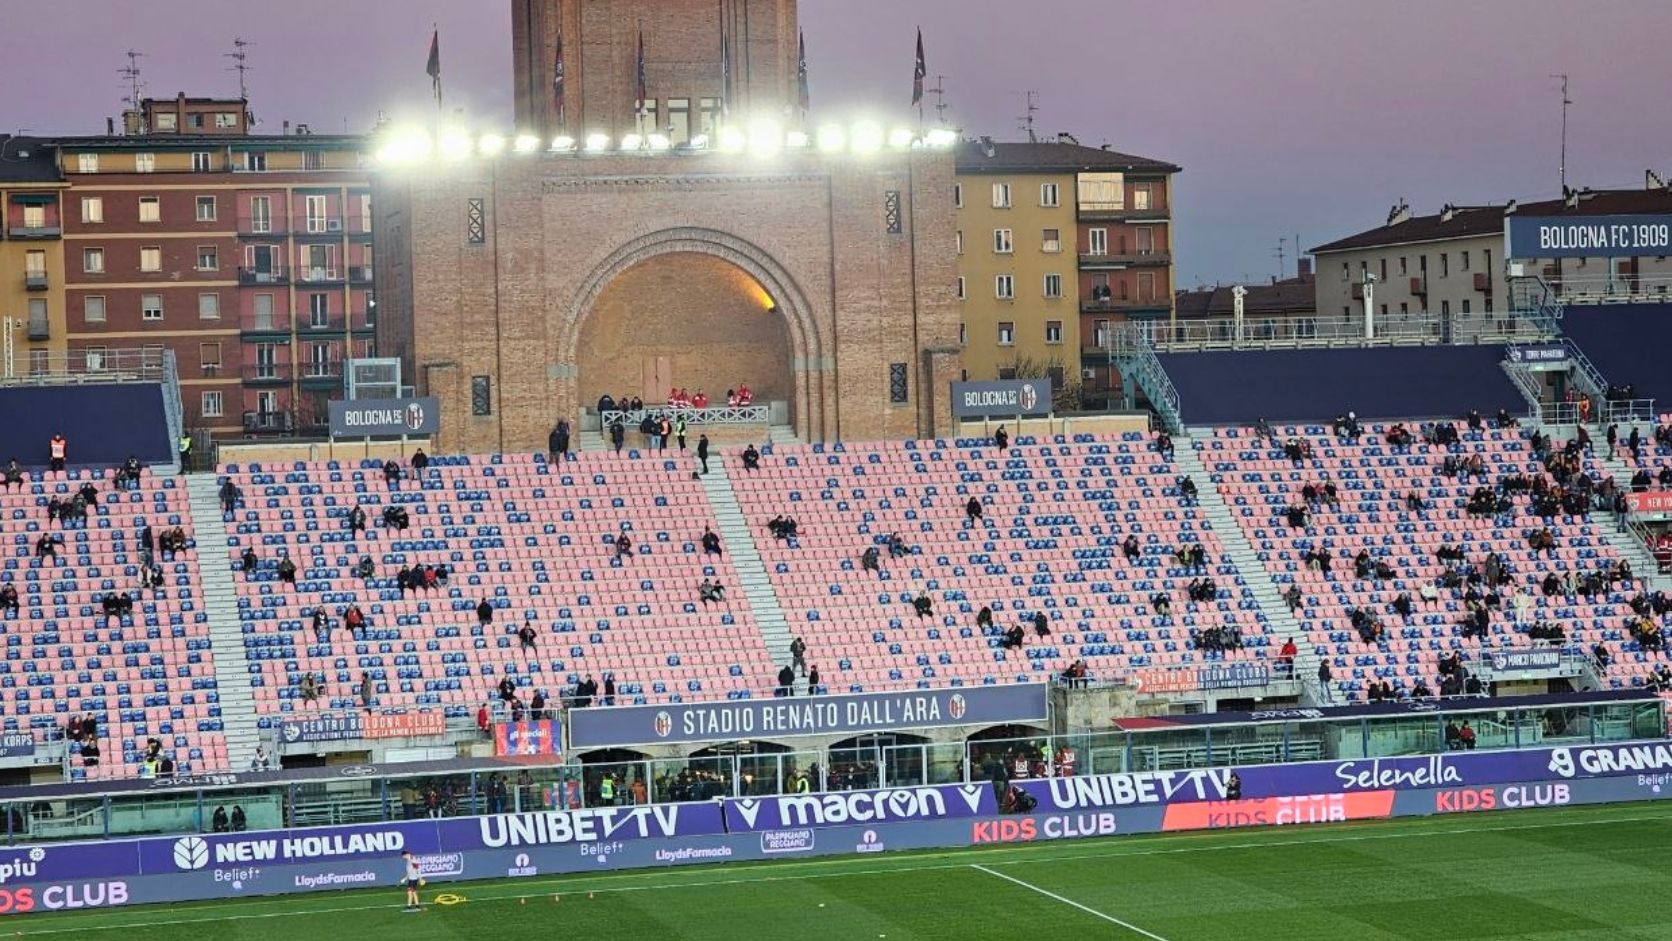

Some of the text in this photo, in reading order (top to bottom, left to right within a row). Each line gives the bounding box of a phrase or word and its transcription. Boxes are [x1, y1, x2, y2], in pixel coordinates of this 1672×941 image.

[1540, 224, 1669, 249] BOLOGNA FC 1909
[964, 390, 1009, 407] BOLOGNA
[345, 409, 393, 426] BOLOGNA
[303, 714, 442, 733] CENTRO BOLOGNA CLUBS
[683, 696, 941, 736] STADIO RENATO DALL'ARA
[1336, 755, 1463, 789] Selenella
[1051, 773, 1175, 809] UNIBET
[1436, 783, 1571, 812] KIDS CLUB
[778, 788, 946, 825] macron
[480, 809, 617, 848] UNIBET
[973, 813, 1116, 843] KIDS CLUB
[216, 831, 404, 863] NEW HOLLAND
[656, 846, 732, 863] LloydsFarmacia
[295, 871, 376, 888] LloydsFarmacia
[43, 881, 129, 909] CLUB
